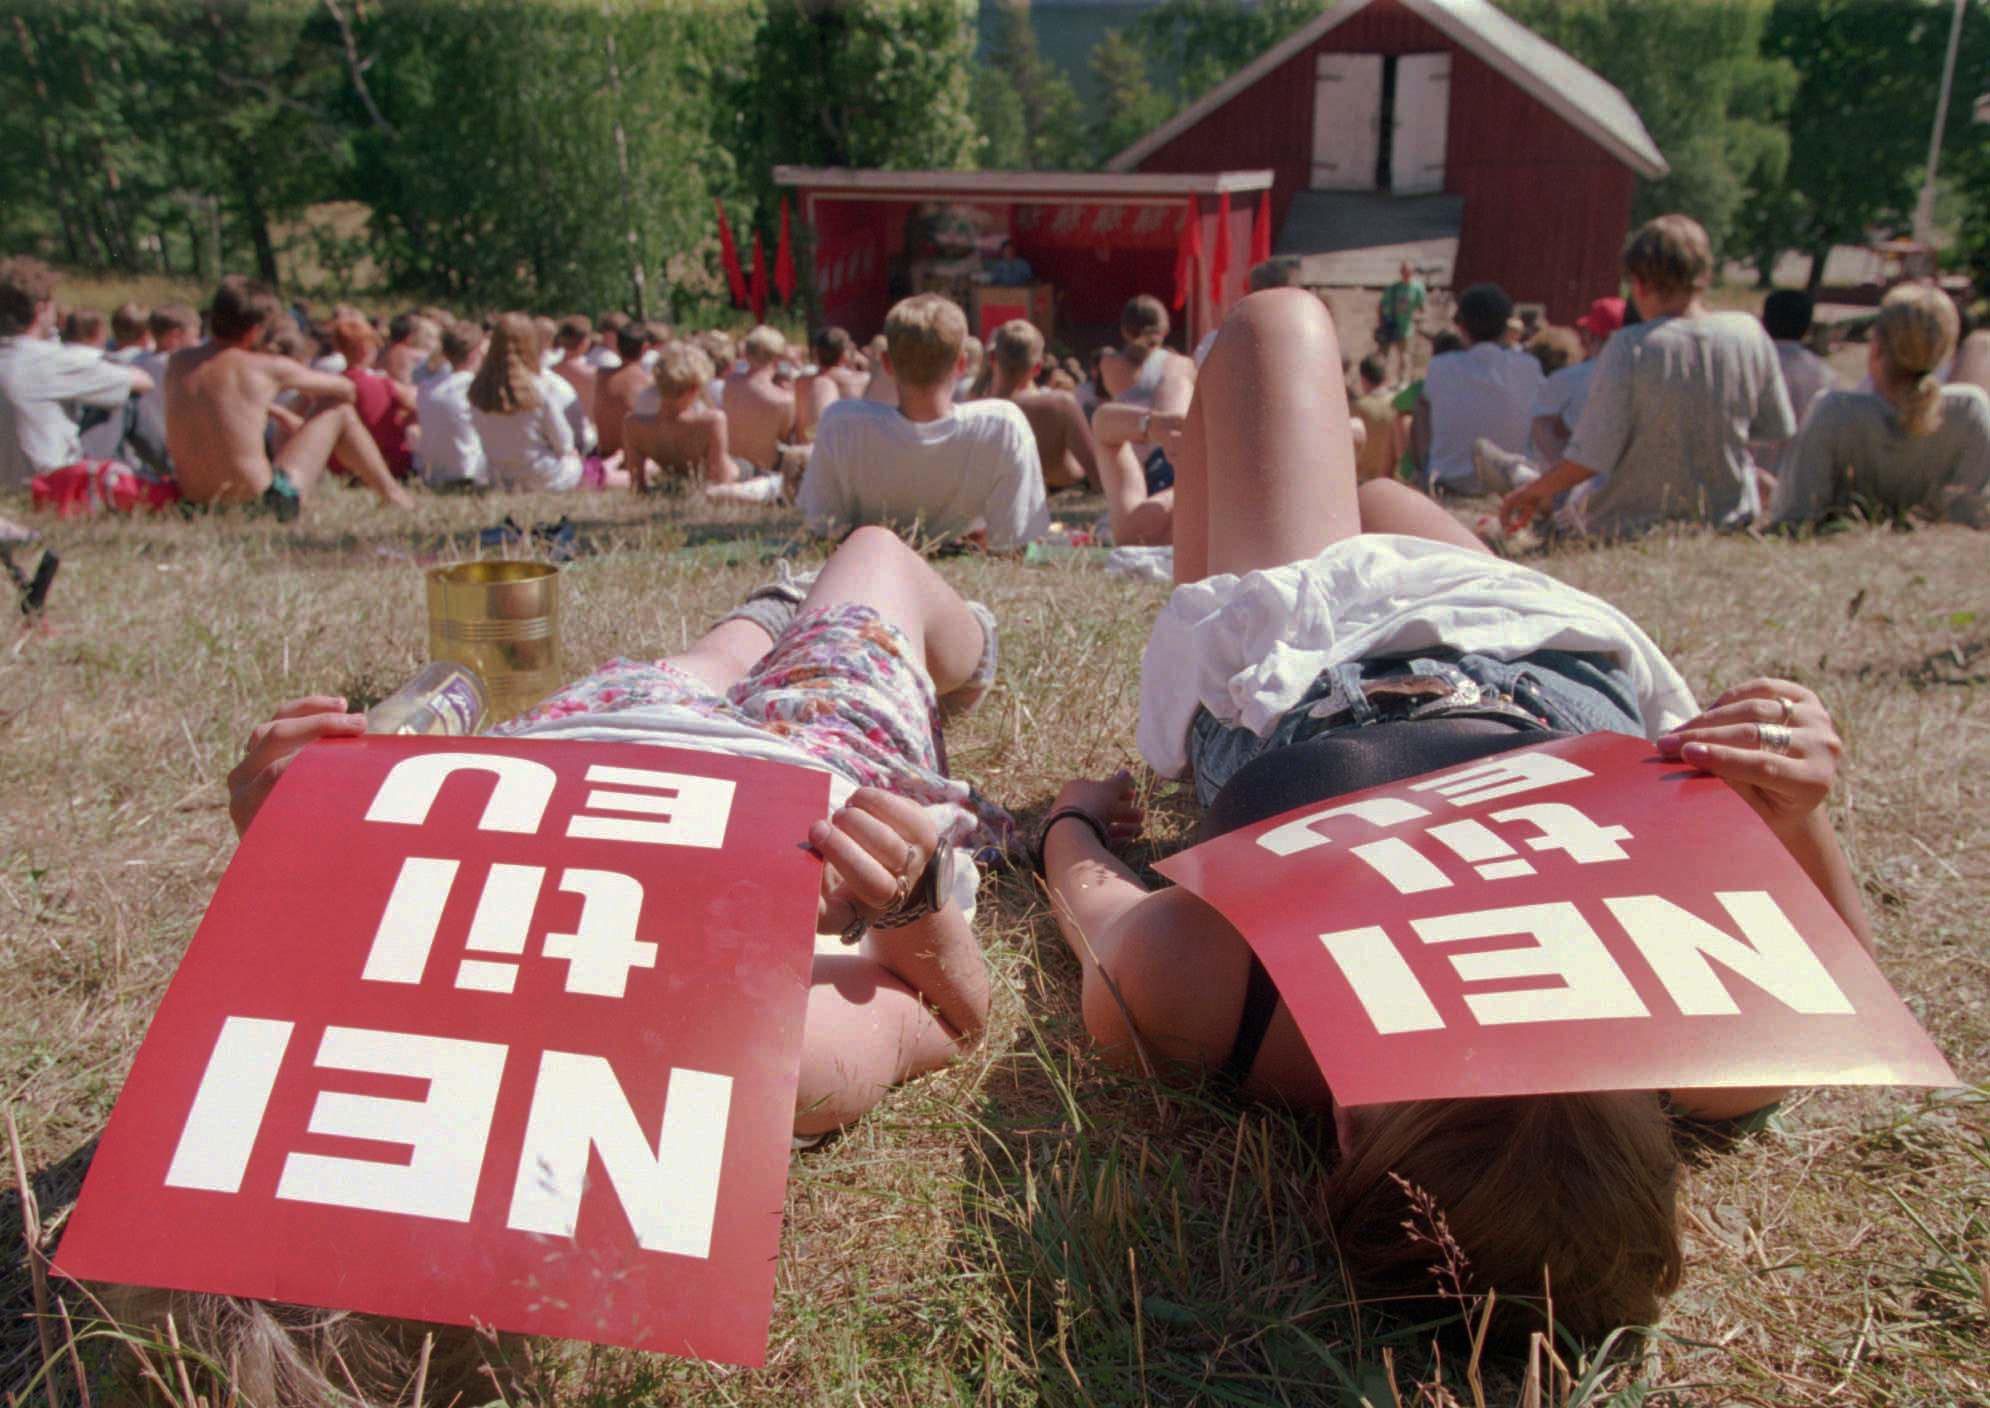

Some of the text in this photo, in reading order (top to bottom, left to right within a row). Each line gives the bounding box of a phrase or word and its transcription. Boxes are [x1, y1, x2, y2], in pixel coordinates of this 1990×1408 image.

[365, 753, 737, 849] EU
[1256, 752, 1595, 857] EU
[1349, 803, 1634, 894] til
[362, 857, 658, 998] til
[1319, 890, 1856, 1035] NEI
[165, 1016, 735, 1259] NEI
